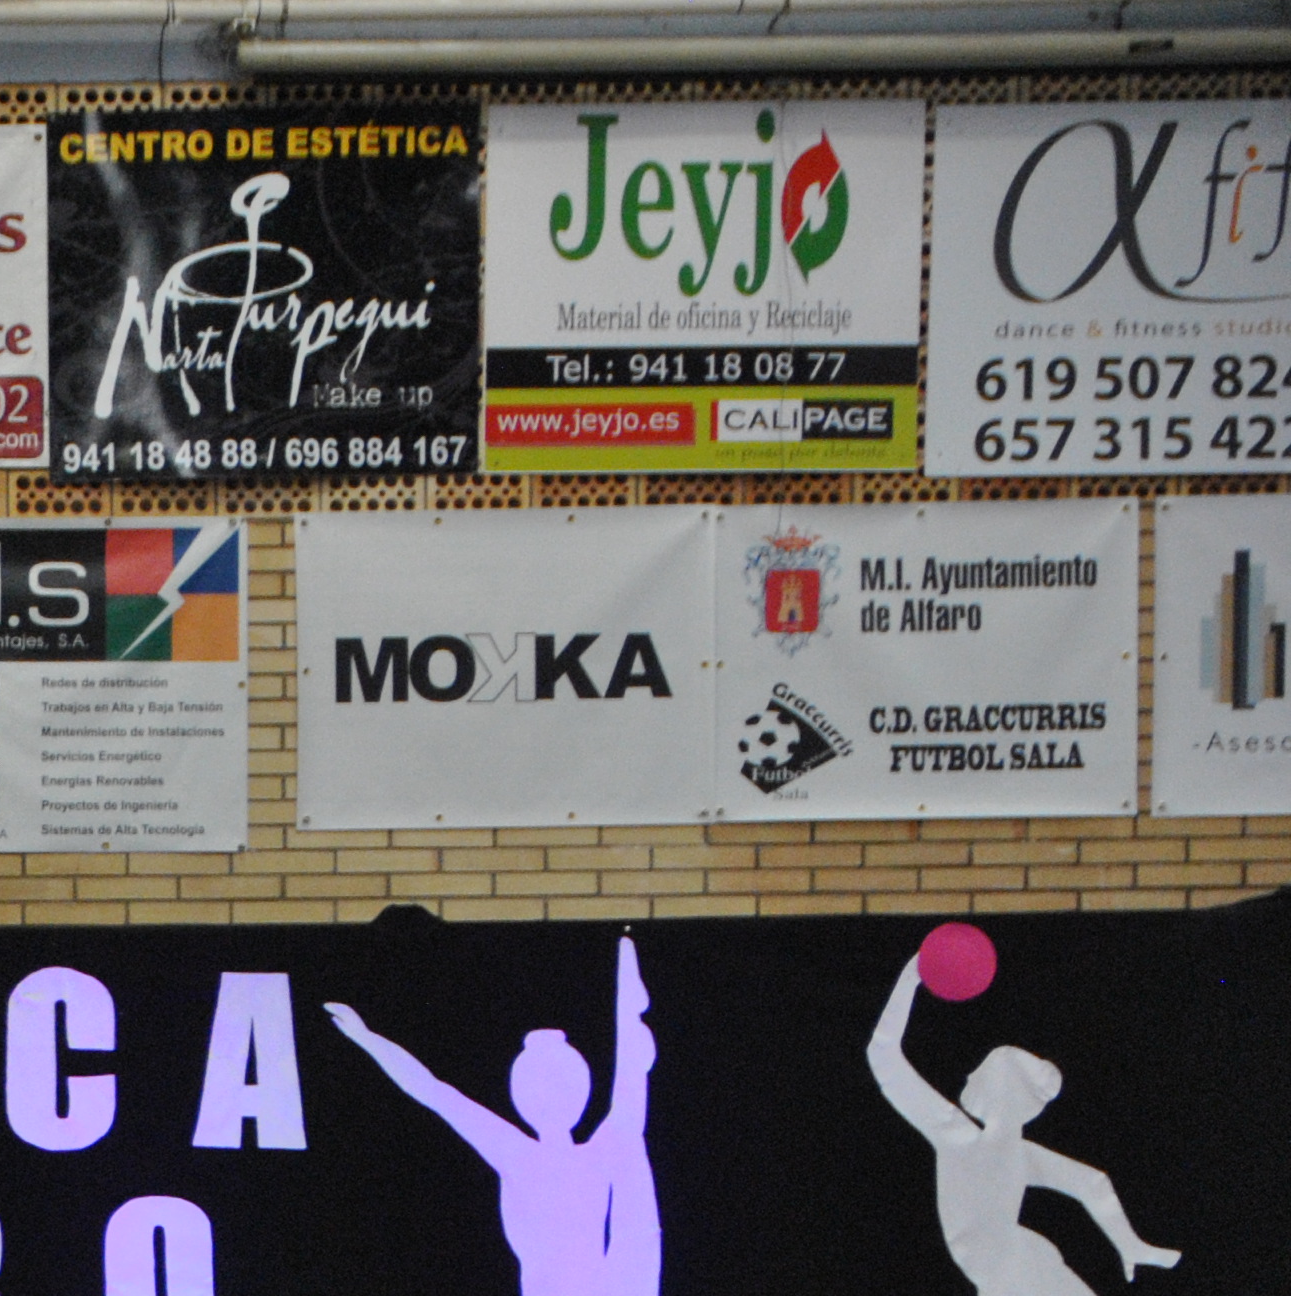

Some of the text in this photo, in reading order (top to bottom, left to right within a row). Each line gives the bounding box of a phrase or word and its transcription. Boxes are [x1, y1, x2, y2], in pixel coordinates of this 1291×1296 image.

[59, 119, 468, 164] CENTRO DE ESTÉTICA
[556, 300, 852, 335] Material de oficina y Reciclaje
[994, 320, 1075, 339] dance
[1086, 321, 1103, 338] &
[1114, 319, 1202, 338] fitness
[545, 352, 846, 383] Tel.: 941 18 08 77
[976, 355, 1078, 402] 619
[1094, 355, 1196, 401] 507
[399, 386, 433, 411] up
[497, 408, 680, 437] www.jeyjo.es
[63, 442, 116, 473] 941
[130, 441, 165, 471] 18
[175, 440, 210, 469] 48
[222, 439, 258, 469] 88
[284, 438, 339, 468] 696
[348, 437, 402, 466] 884
[413, 435, 467, 467] 167
[974, 418, 1076, 463] 657
[1093, 416, 1194, 462] 315
[860, 554, 1098, 594] M.I. Ayuntamiento
[861, 601, 982, 633] de Alfaro
[41, 676, 77, 688] Redes
[81, 676, 96, 688] de
[42, 701, 91, 714] Trabajos
[94, 704, 109, 712] en
[111, 701, 134, 712] Alta
[869, 703, 1107, 735] C.D. GRACCURRIS
[41, 726, 225, 737] Mantenimiento de Instalaciones
[41, 750, 95, 762] Servicios
[890, 742, 1084, 773] FUTBOL SALA
[96, 775, 164, 787] Renovables
[41, 800, 100, 813] Proyectos
[103, 800, 118, 811] de
[41, 824, 94, 835] Sistemas
[97, 824, 112, 835] de
[115, 824, 138, 835] Alta
